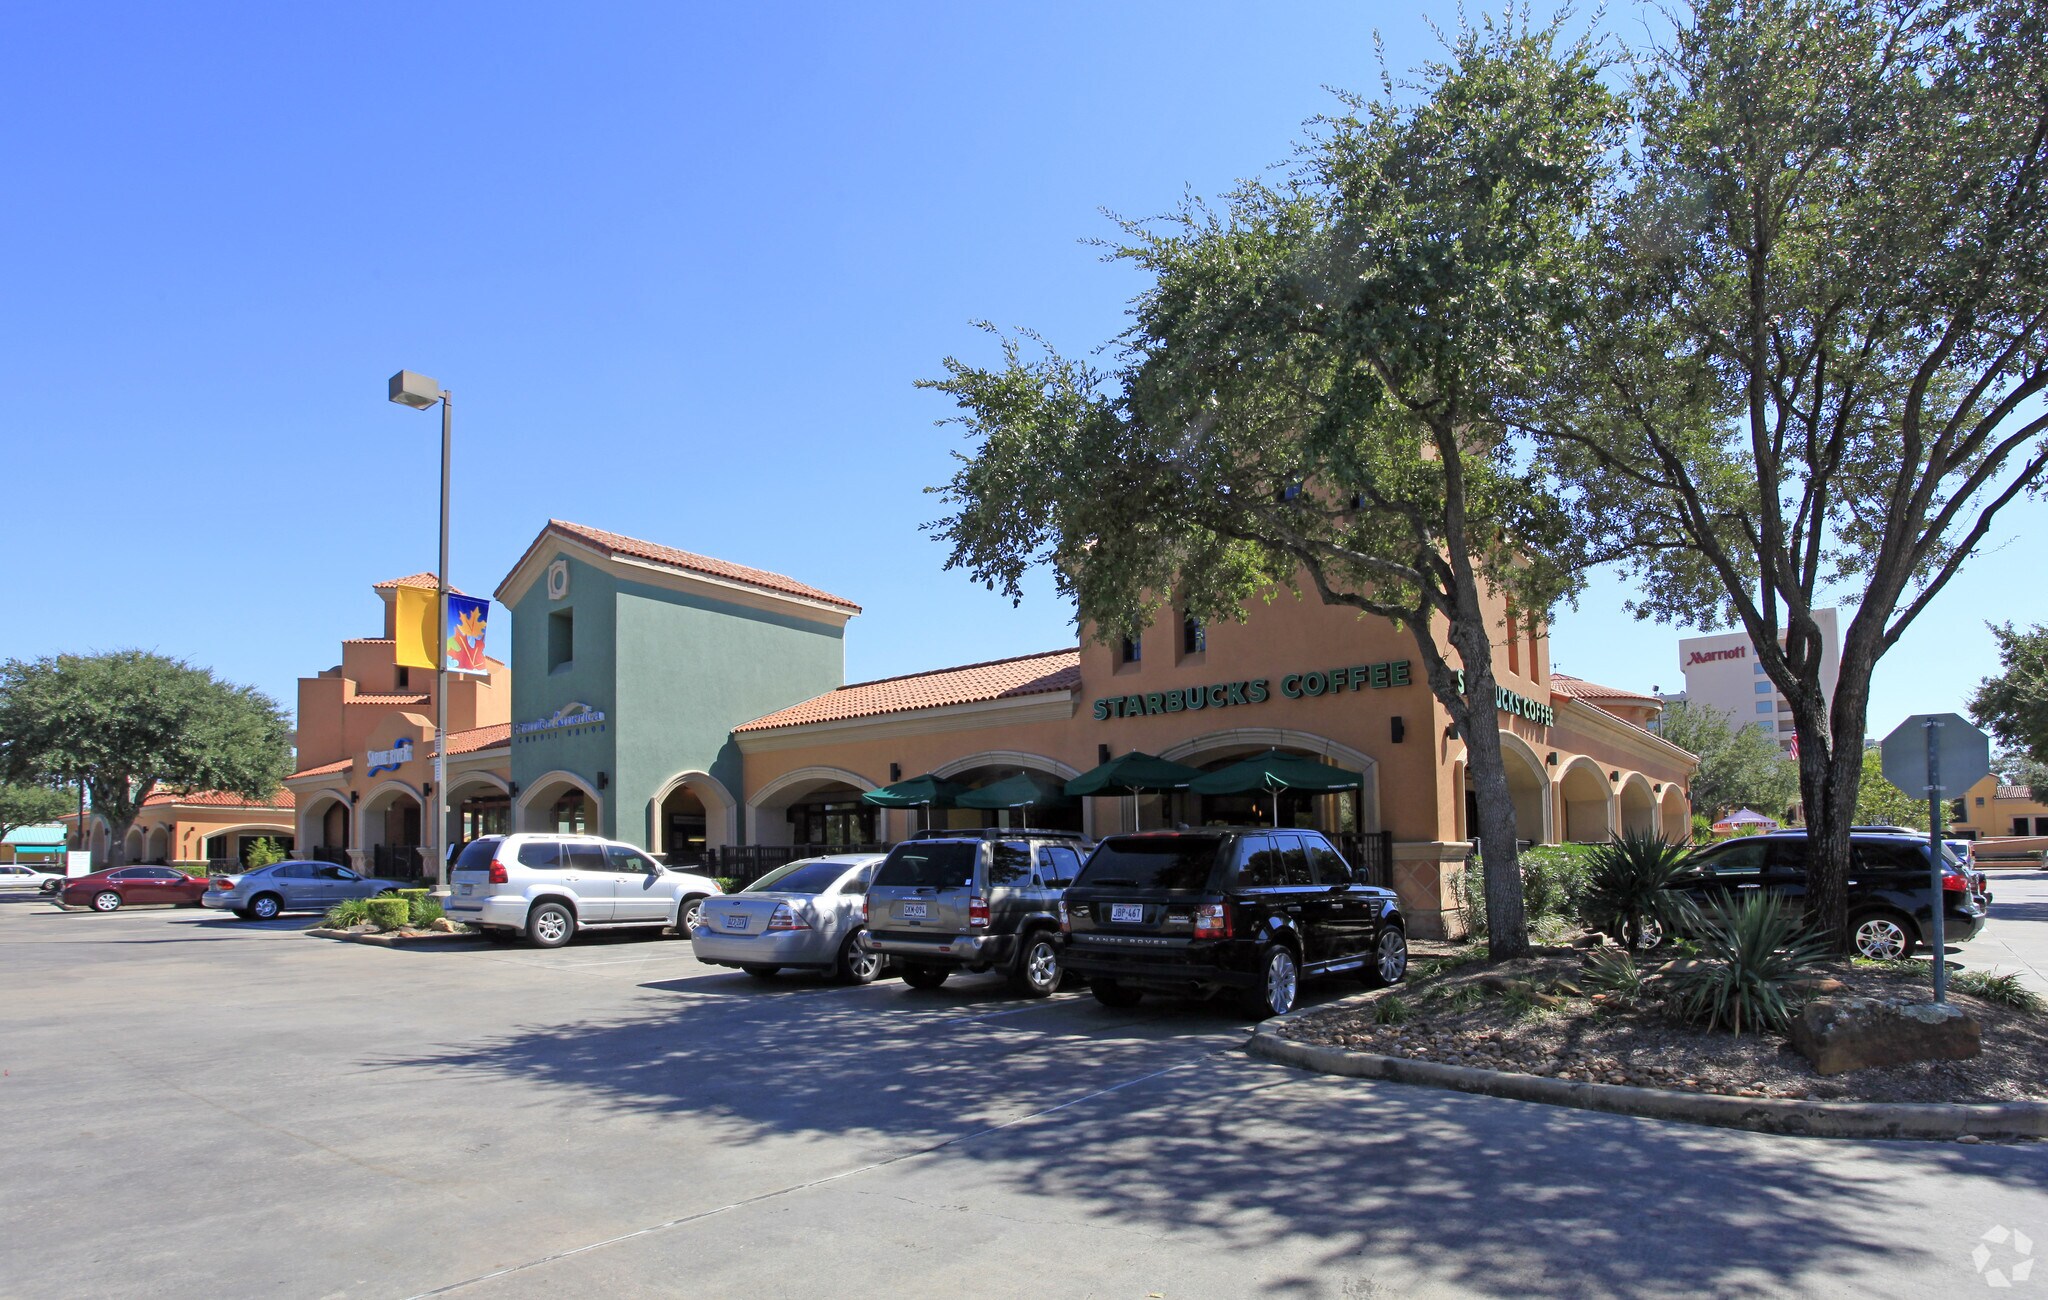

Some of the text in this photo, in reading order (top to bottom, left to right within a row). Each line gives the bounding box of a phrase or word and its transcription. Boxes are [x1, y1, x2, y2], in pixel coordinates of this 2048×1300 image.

[1686, 645, 1745, 666] Marriott
[1093, 660, 1411, 721] STARBUCKS COFFEE
[1457, 669, 1554, 728] SUCKS COFFEE
[1113, 906, 1141, 918] JBP-467
